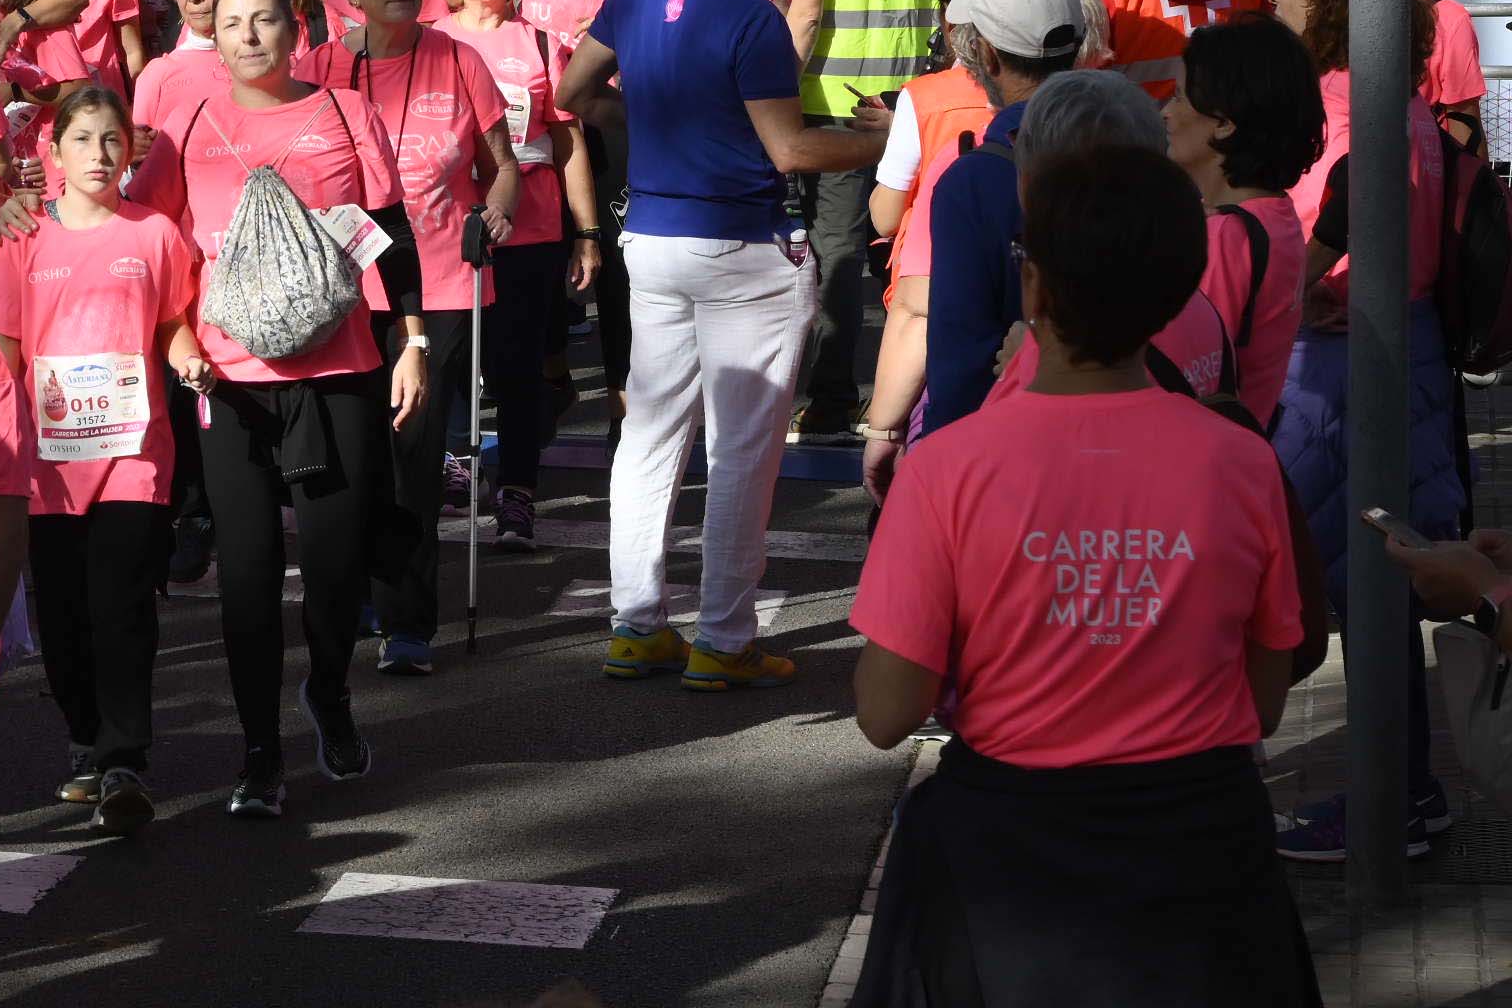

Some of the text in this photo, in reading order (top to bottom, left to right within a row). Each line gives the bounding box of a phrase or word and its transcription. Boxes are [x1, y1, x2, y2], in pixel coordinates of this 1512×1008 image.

[529, 1, 552, 23] TU
[27, 266, 71, 285] OYSHO
[70, 395, 110, 413] 016
[76, 414, 106, 426] 31572
[51, 430, 79, 438] CARRERA
[80, 429, 90, 437] DE
[90, 428, 99, 436] LA
[100, 425, 124, 435] MUJER
[49, 441, 81, 455] OYSHO
[1021, 528, 1196, 562] CARRERA
[1055, 562, 1161, 595] DE LA
[1045, 596, 1163, 628] MUJER
[1088, 633, 1122, 646] 2023
